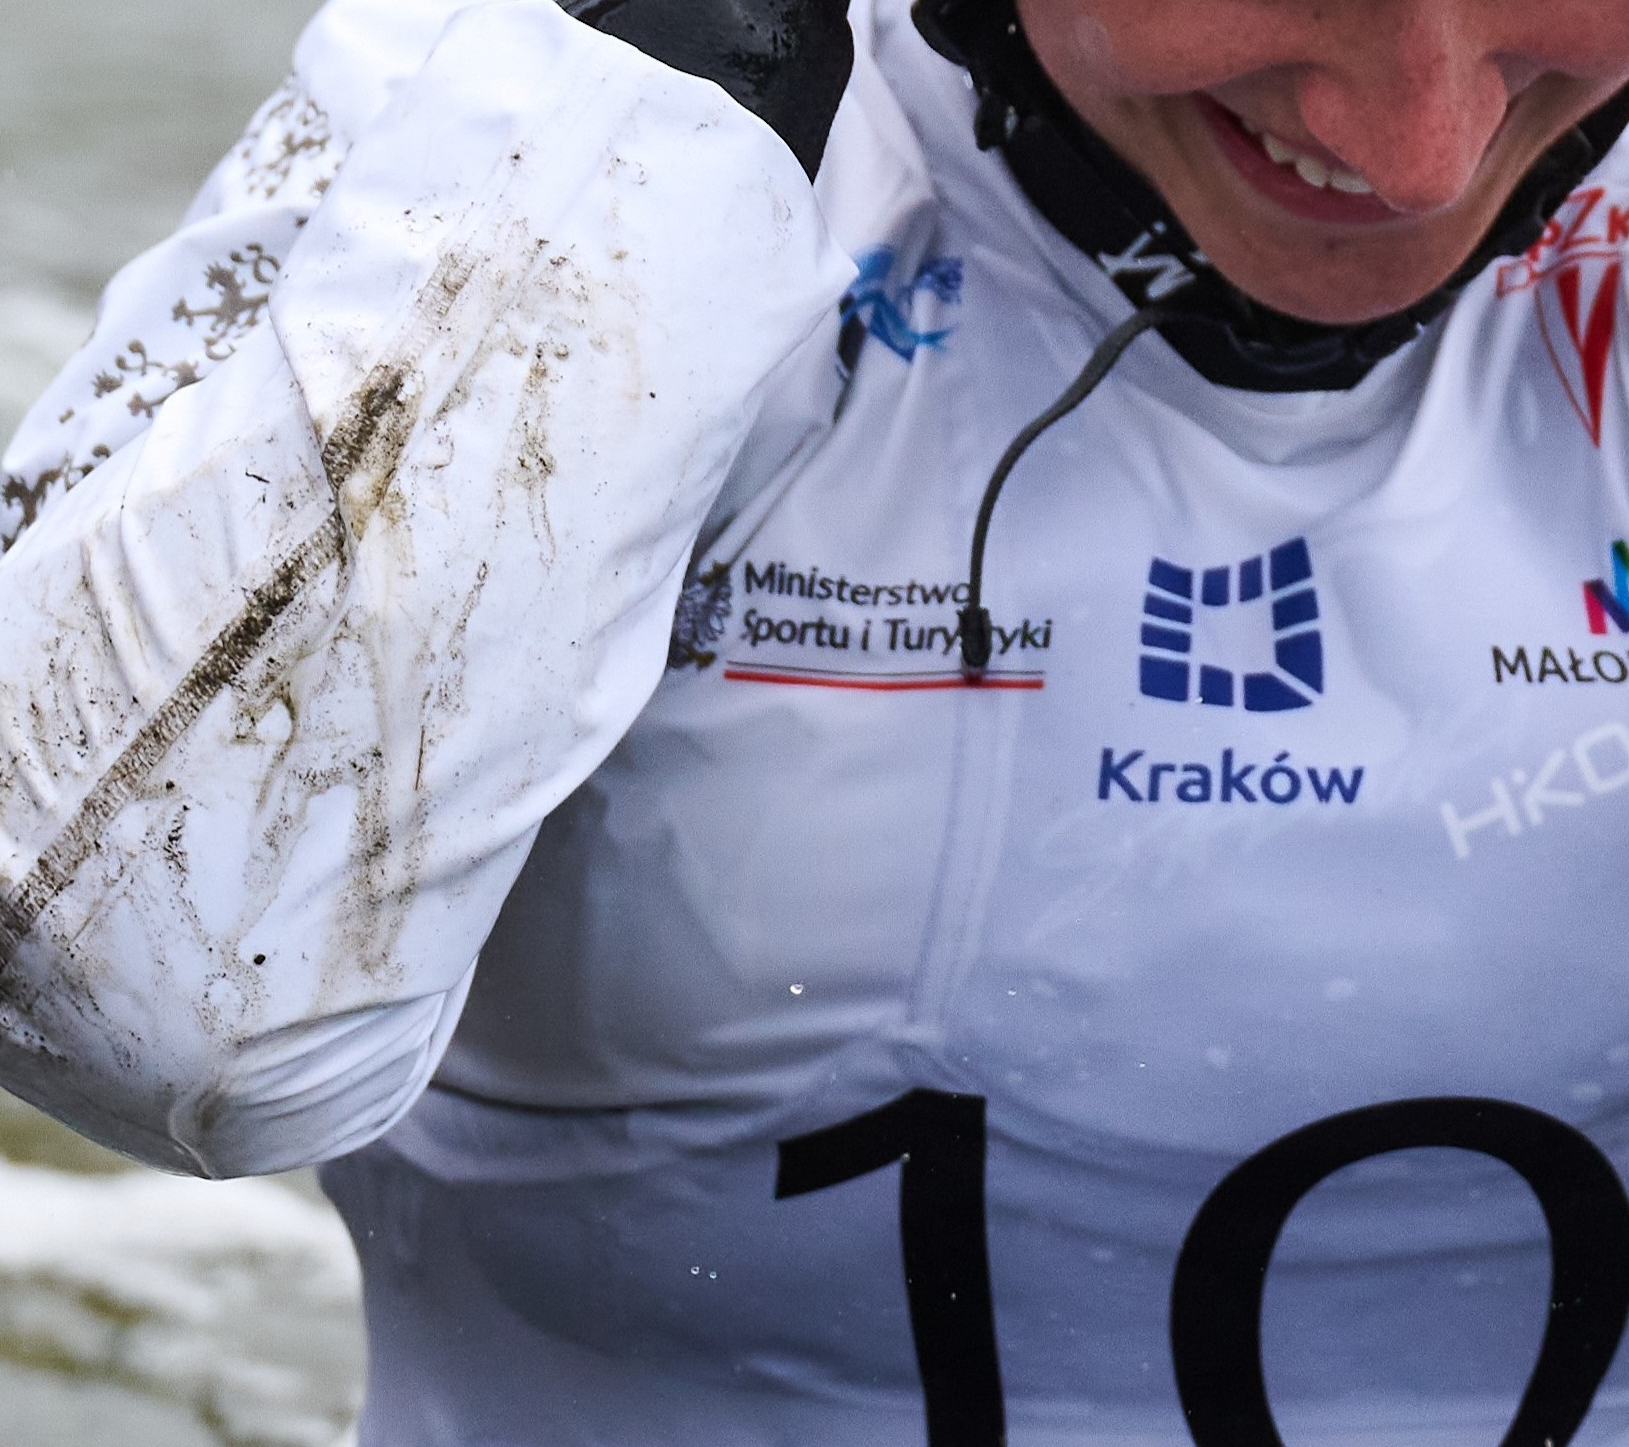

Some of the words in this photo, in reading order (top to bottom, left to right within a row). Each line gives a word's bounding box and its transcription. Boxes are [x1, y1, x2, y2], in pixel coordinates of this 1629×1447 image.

[743, 609, 851, 650] Sportu
[859, 618, 872, 652] i
[883, 616, 1053, 656] Turyyki
[1097, 747, 1365, 805] Kraków
